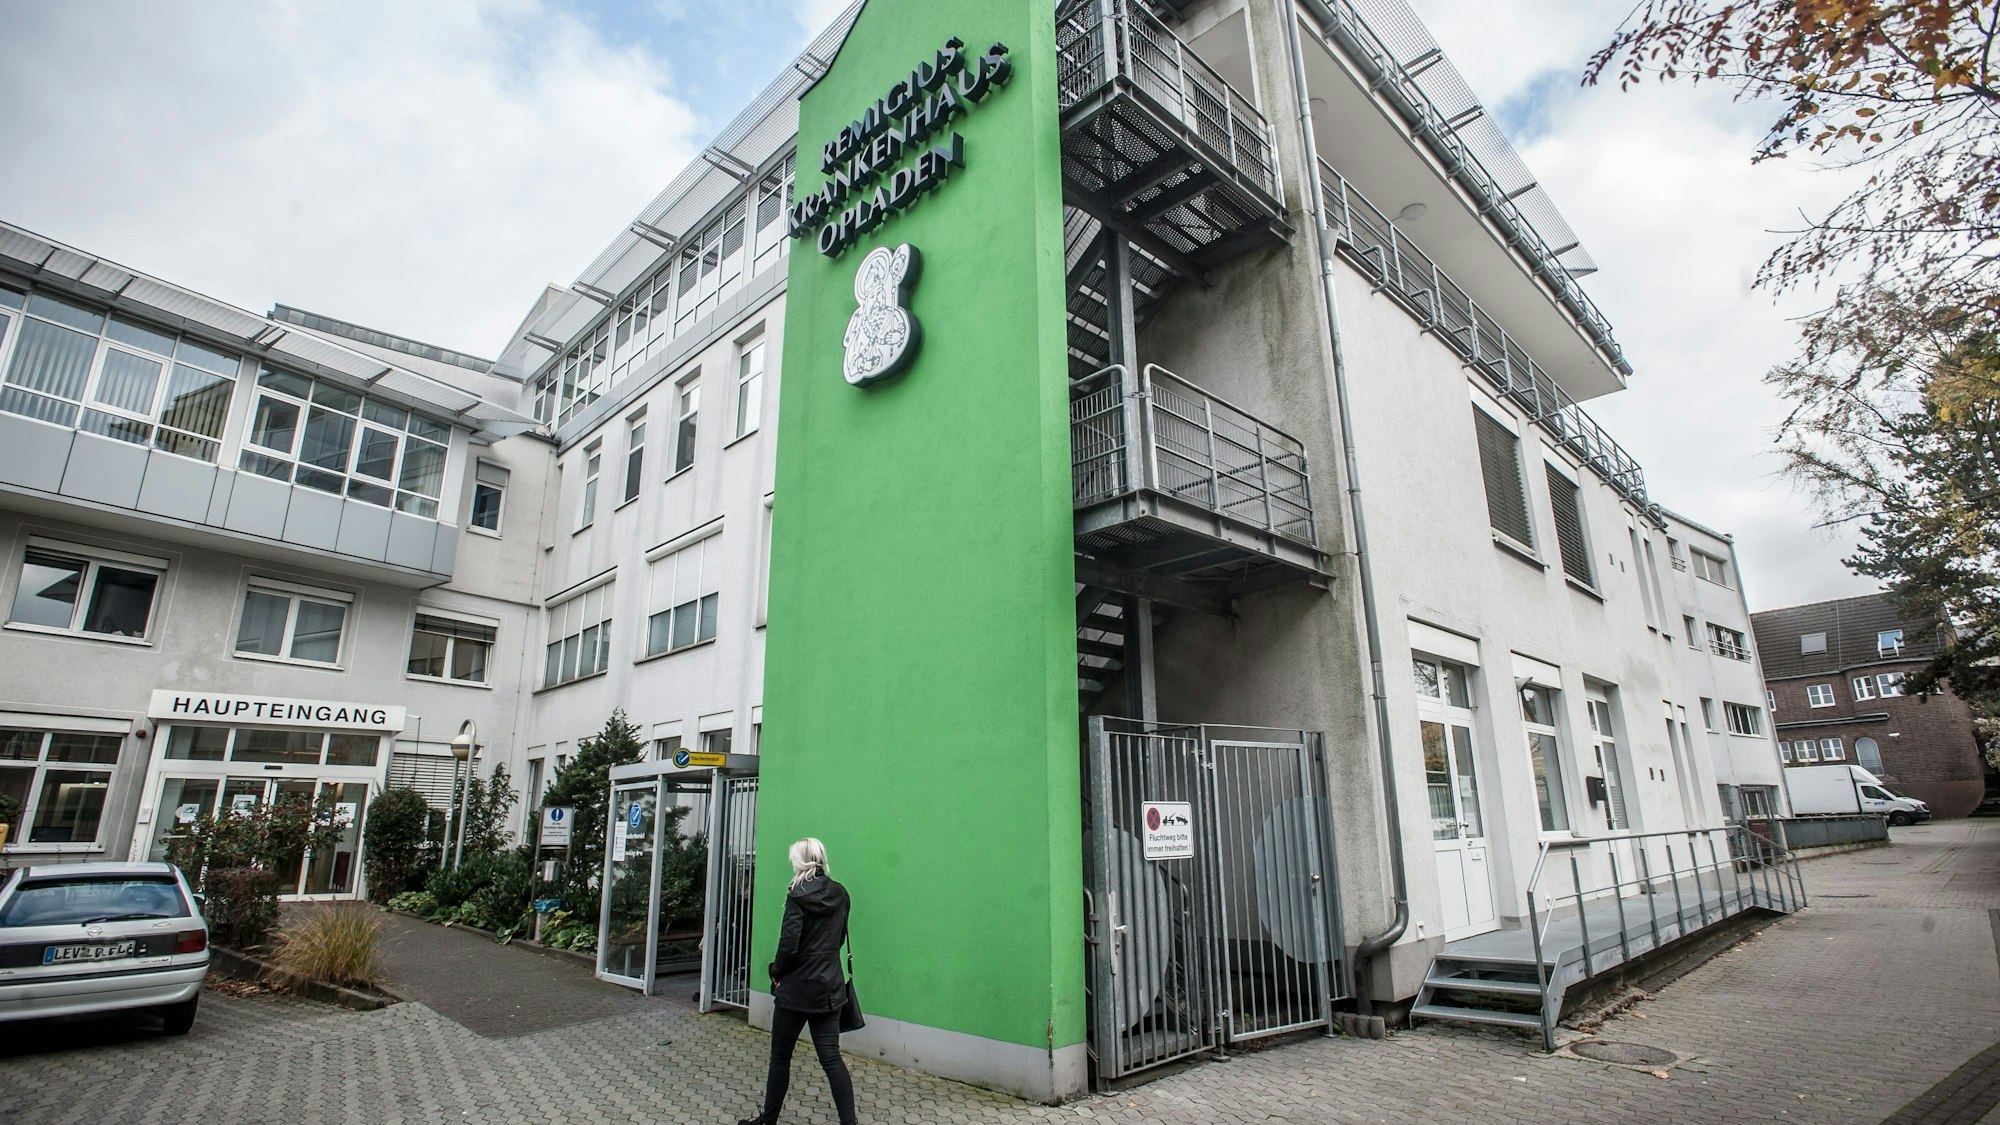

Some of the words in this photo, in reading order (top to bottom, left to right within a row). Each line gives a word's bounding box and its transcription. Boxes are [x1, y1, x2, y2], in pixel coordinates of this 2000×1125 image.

[821, 36, 965, 175] REMIGIUS
[787, 42, 1011, 238] KRANKENHAUS
[817, 131, 964, 257] OPLADEN
[172, 697, 387, 725] HAUPTEINGANG
[1147, 845, 1164, 853] immer
[1164, 844, 1188, 852] freihalten
[1149, 833, 1176, 842] Fluchtweg
[1176, 833, 1188, 841] bitte
[54, 947, 81, 960] LEV
